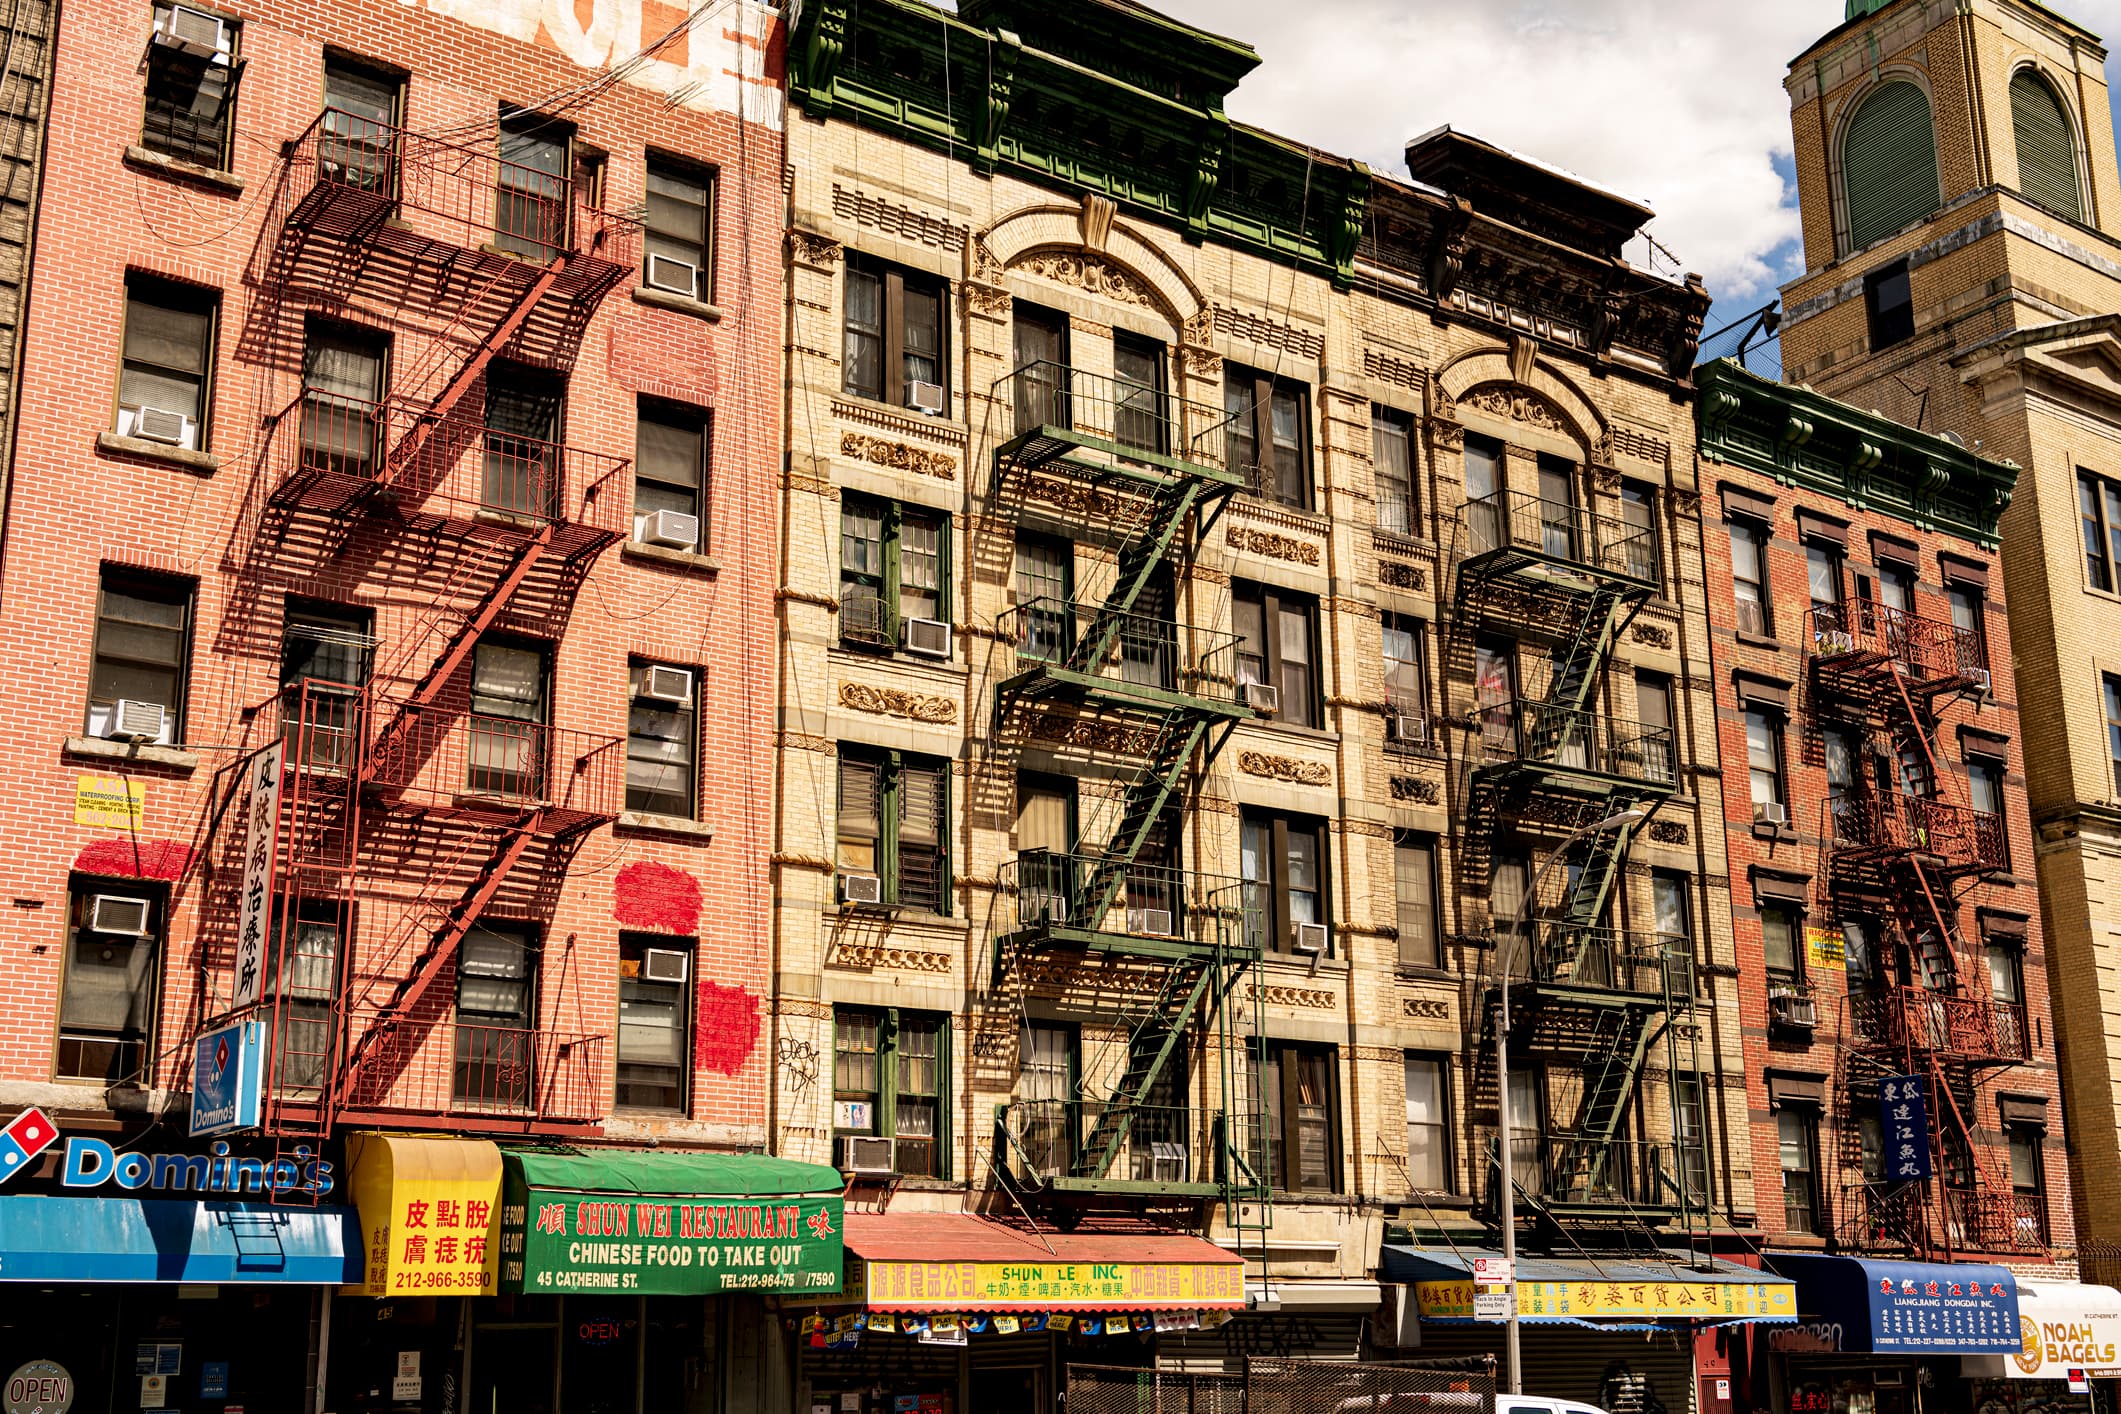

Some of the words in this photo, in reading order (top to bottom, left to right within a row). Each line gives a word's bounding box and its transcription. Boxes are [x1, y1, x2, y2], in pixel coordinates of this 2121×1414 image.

[80, 791, 124, 802] WATERPROOFING
[195, 1102, 234, 1128] Domino's
[62, 1136, 335, 1196] Domino's
[510, 1205, 524, 1226] FOOD
[536, 1202, 566, 1236] 順
[576, 1202, 630, 1237] SHUN
[636, 1203, 672, 1238] WEI
[680, 1205, 800, 1240] RESTAURANT
[806, 1206, 836, 1240] 味
[510, 1233, 523, 1253] OUT
[569, 1242, 642, 1265] CHINESE
[646, 1244, 692, 1266] FOOD
[698, 1246, 719, 1267] TO
[724, 1246, 765, 1267] TAKE
[770, 1245, 802, 1266] OUT
[396, 1272, 491, 1288] 212-966-3590
[536, 1271, 552, 1286] 45
[556, 1272, 617, 1288] CATHERINE
[622, 1274, 638, 1288] ST.
[720, 1272, 835, 1288] TEL:212-964-75/7590
[874, 1264, 976, 1298] 源源食品公司
[1002, 1267, 1042, 1281] SHUN
[1058, 1266, 1075, 1281] LE
[1093, 1264, 1122, 1280] INC.
[1894, 1298, 1940, 1306] LIANGJIANG
[1944, 1299, 1978, 1308] DONGDAI
[580, 1323, 619, 1338] OPEN
[2043, 1322, 2093, 1342] NOAH
[2046, 1344, 2116, 1364] BAGELS
[10, 1377, 68, 1404] OPEN
